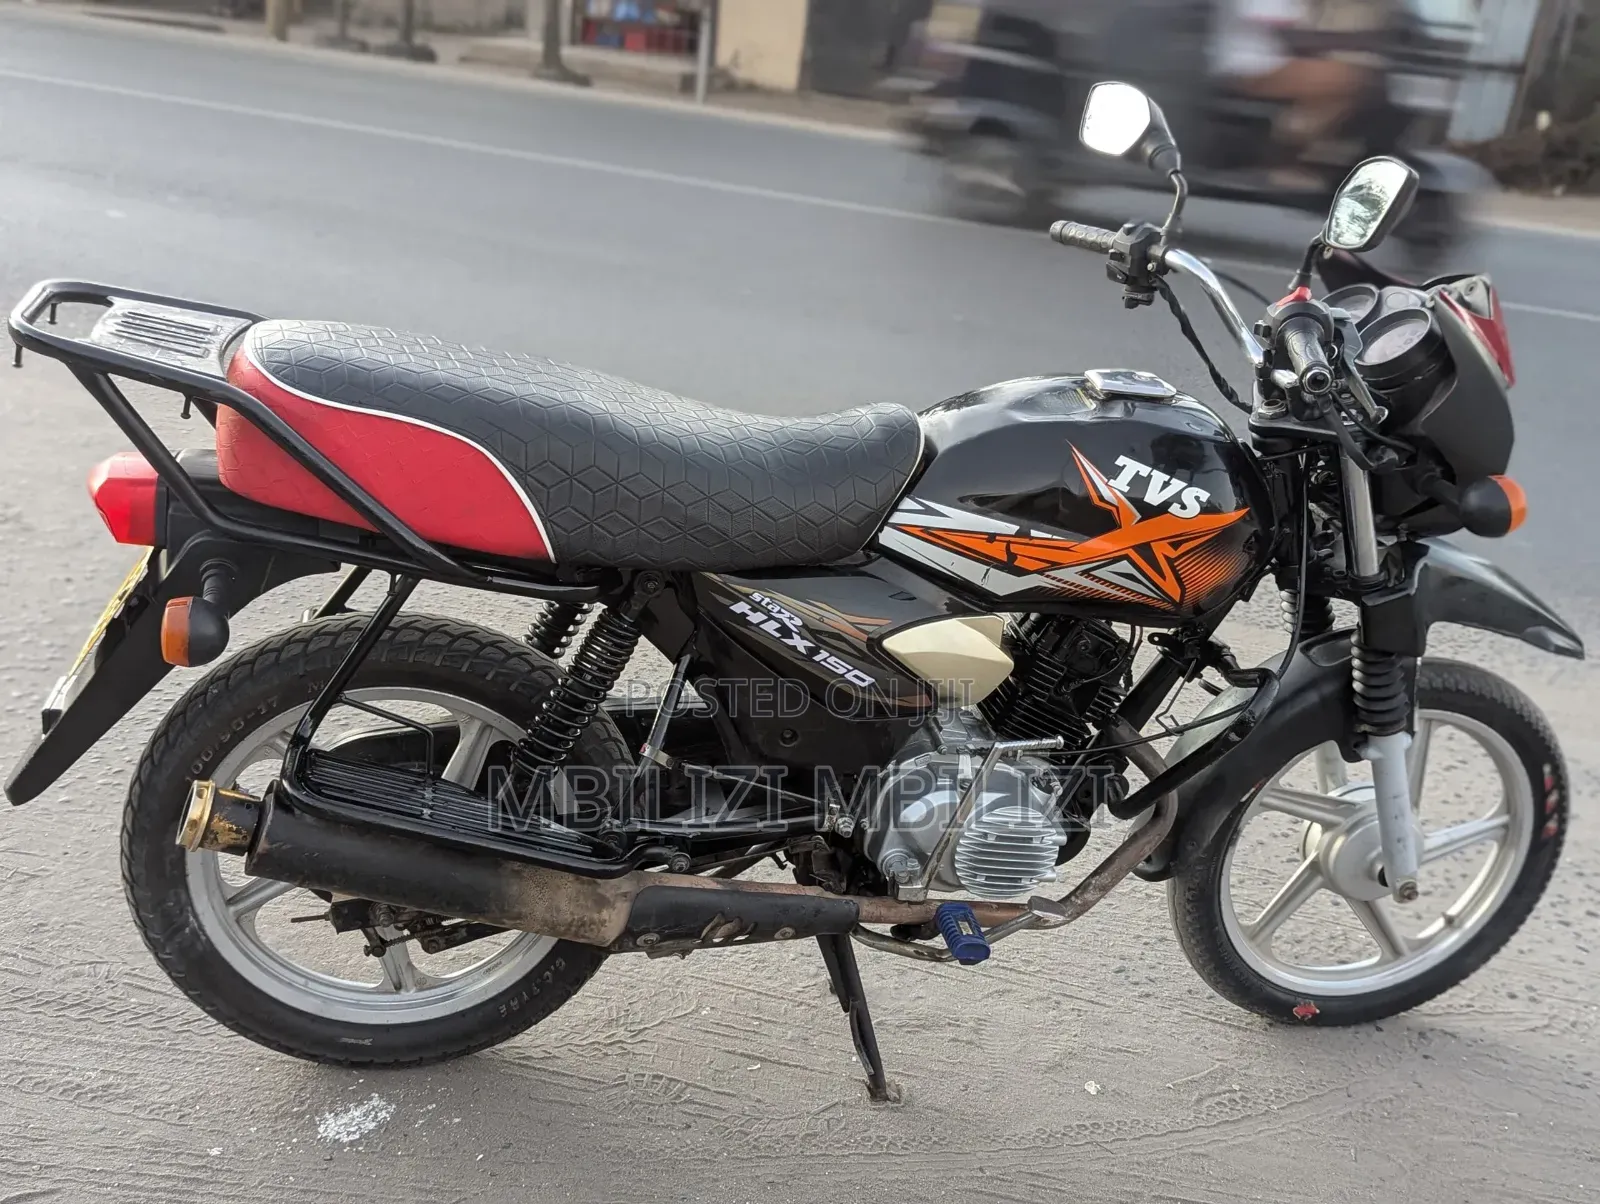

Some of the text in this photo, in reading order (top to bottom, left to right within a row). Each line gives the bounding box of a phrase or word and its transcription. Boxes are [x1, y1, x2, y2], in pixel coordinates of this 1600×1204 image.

[1107, 454, 1211, 519] TVS
[728, 600, 876, 688] HLX 150
